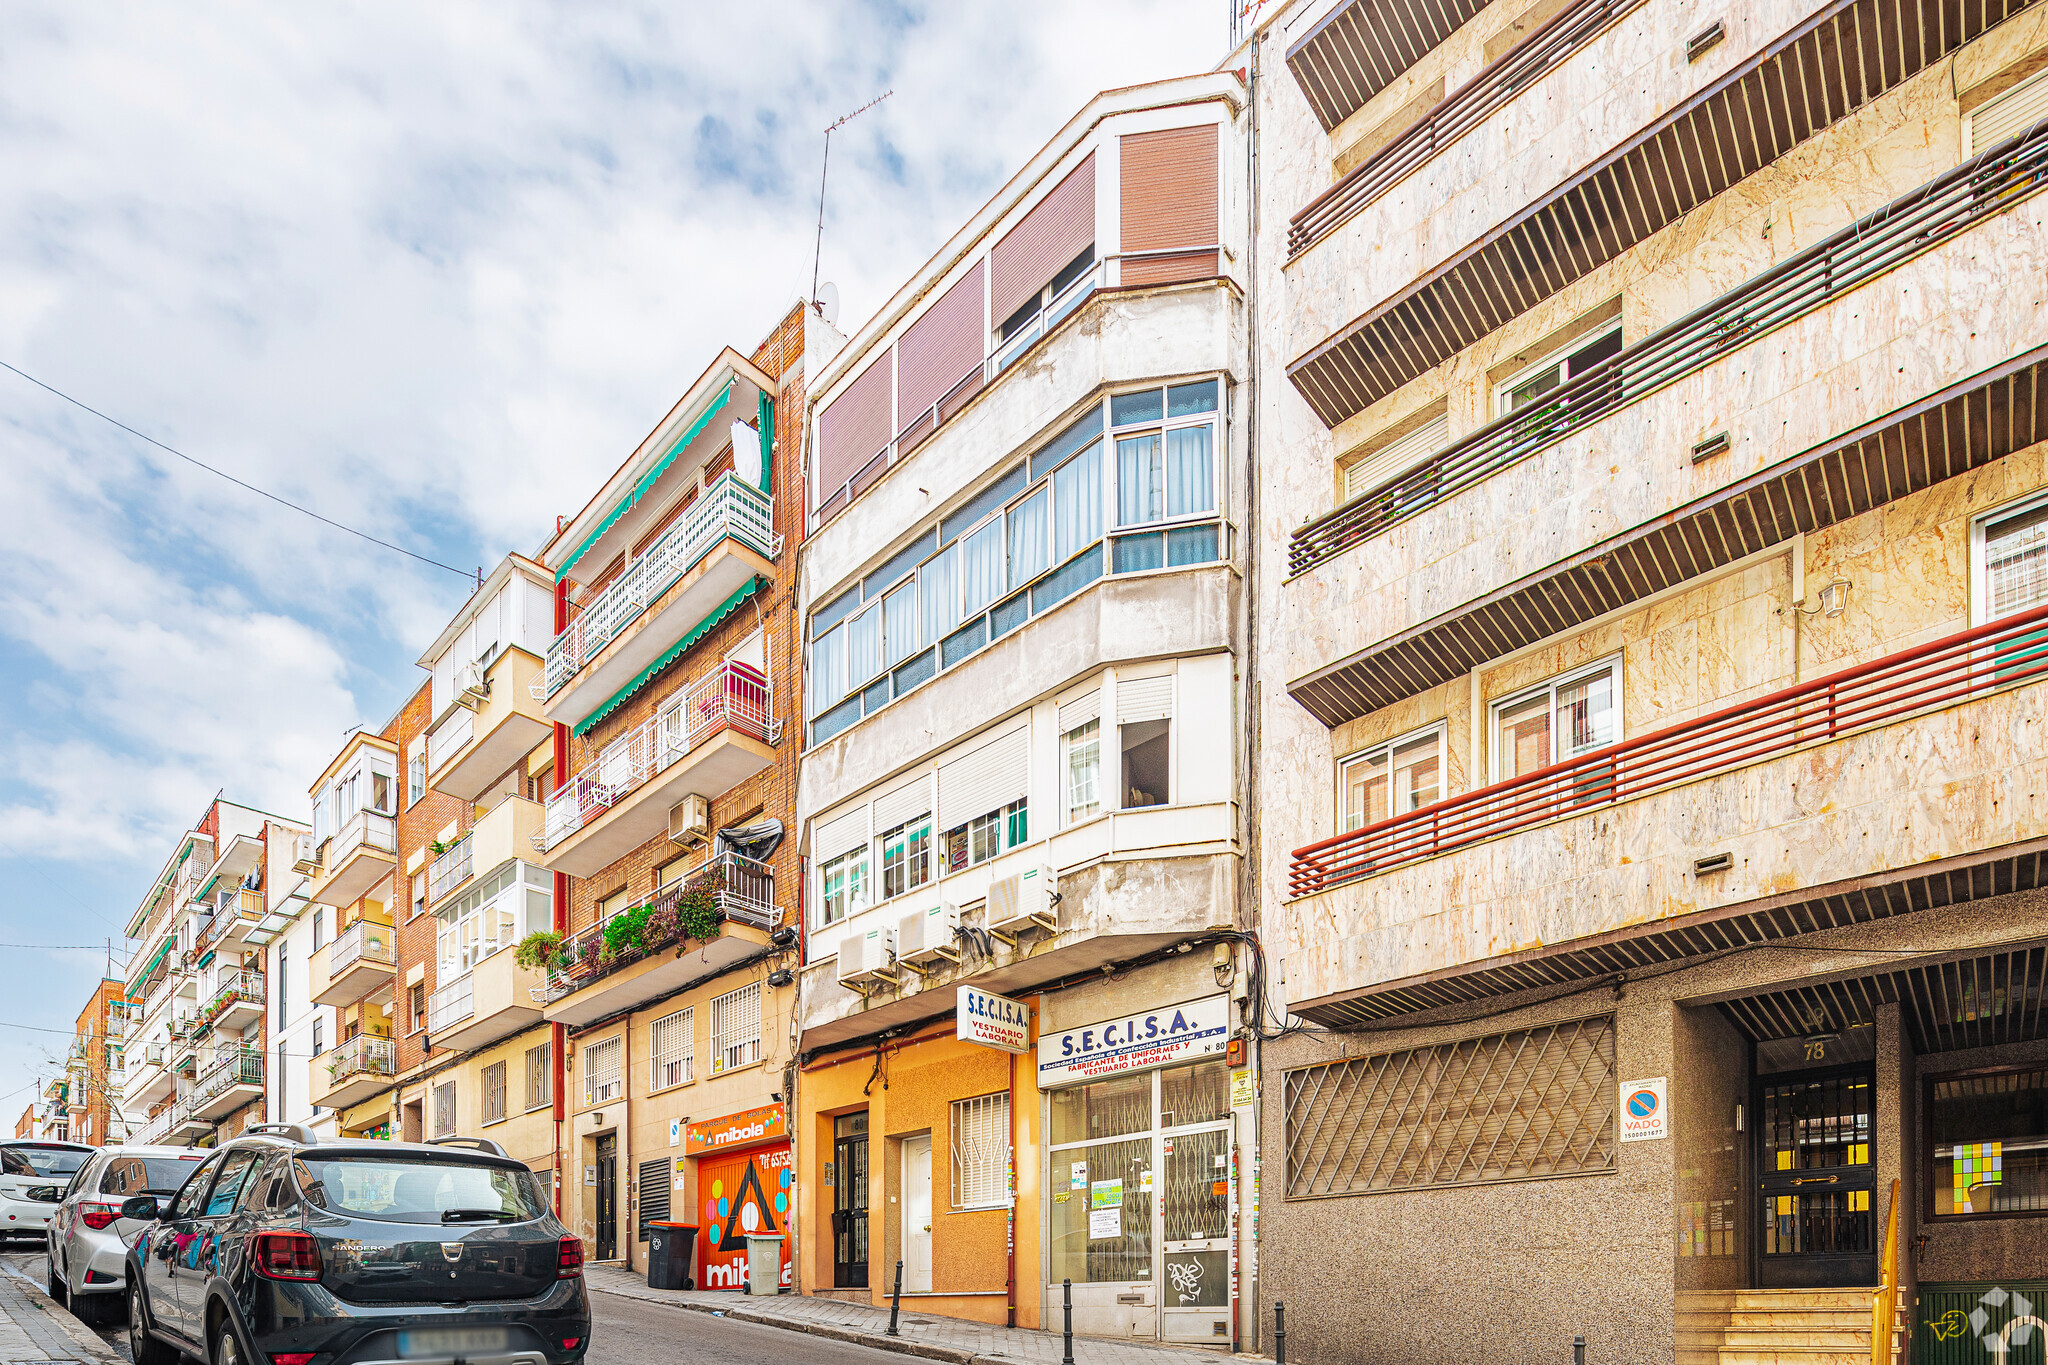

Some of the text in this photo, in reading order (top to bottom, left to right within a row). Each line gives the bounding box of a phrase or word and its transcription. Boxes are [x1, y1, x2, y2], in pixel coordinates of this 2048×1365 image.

[968, 993, 1027, 1027] S.E.C.I.S.A.
[972, 1021, 1023, 1039] VESTUARIO
[976, 1030, 1019, 1046] LABORAL
[1062, 1010, 1198, 1056] S.E.C.I.S.A.
[1043, 1059, 1073, 1070] Sociedad
[1075, 1052, 1105, 1064] Española
[1118, 1042, 1157, 1054] Confección
[1216, 1042, 1225, 1050] 80
[1804, 1042, 1824, 1060] 78
[1068, 1057, 1115, 1072] FABRICANTE
[1119, 1054, 1128, 1062] DE
[1131, 1044, 1180, 1059] UNIFORMES
[1084, 1054, 1172, 1075] VESTUARIO LABORAL
[701, 1108, 771, 1129] PARQUE DE BOLAS
[855, 1119, 863, 1130] 80
[1625, 1119, 1661, 1130] VADO
[715, 1122, 764, 1144] mibola
